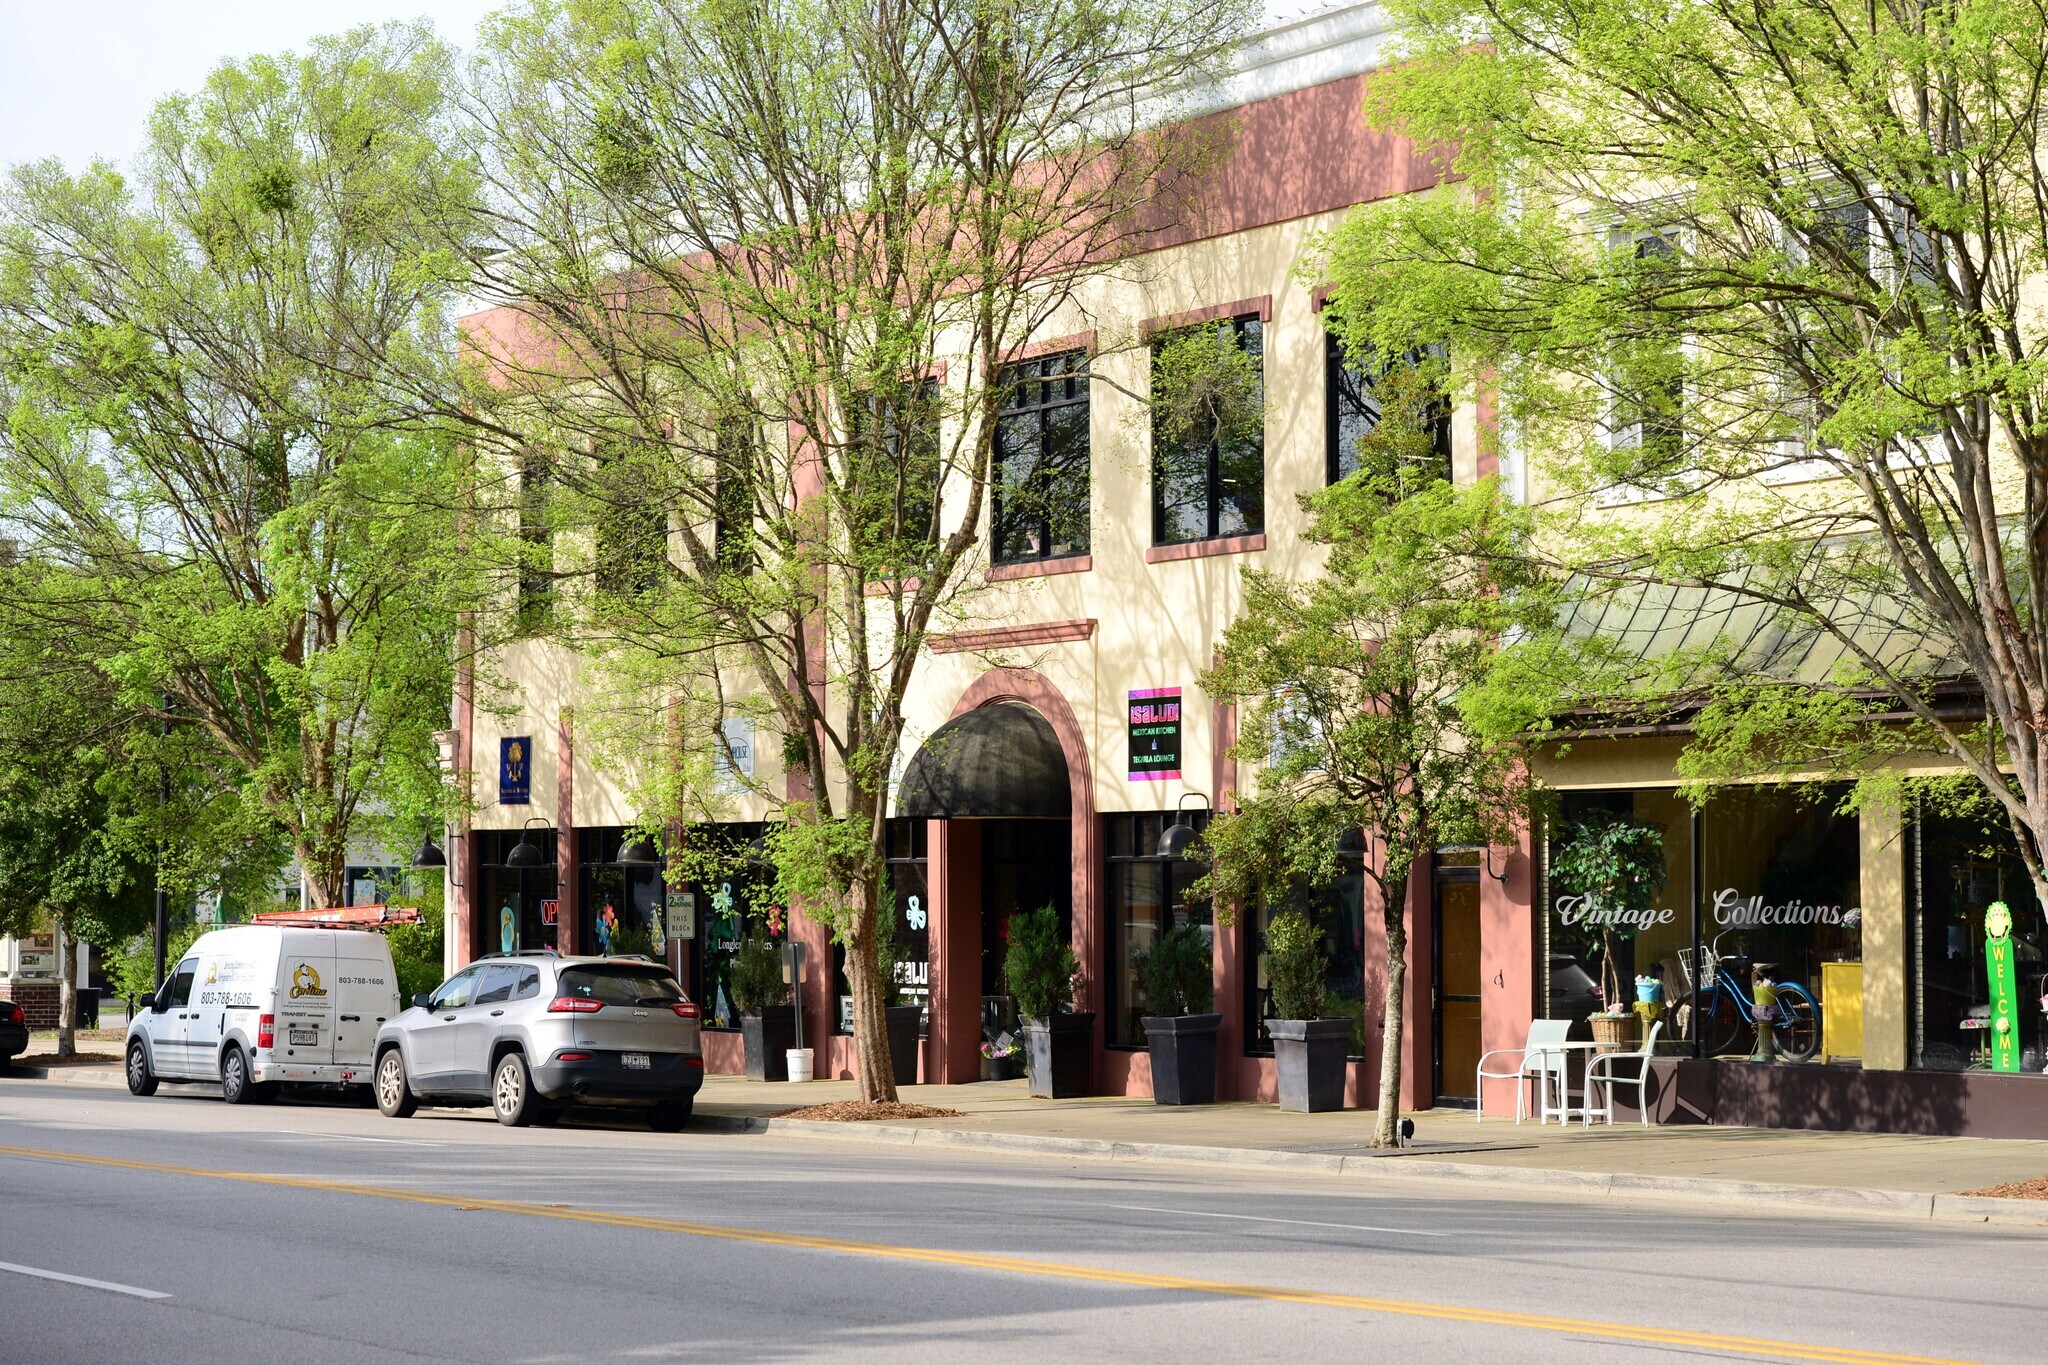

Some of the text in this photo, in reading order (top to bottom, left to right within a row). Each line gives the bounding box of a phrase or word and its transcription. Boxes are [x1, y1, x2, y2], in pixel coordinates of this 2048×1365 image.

[1133, 727, 1176, 736] MEXICAN KITCHEN
[1133, 754, 1175, 763] TEQUILA LOUNGE
[669, 897, 675, 907] 2
[1713, 887, 1844, 925] Collections
[544, 902, 559, 923] OP
[1556, 892, 1676, 931] Vintage
[718, 938, 742, 952] Longlea
[339, 977, 384, 985] 803-788-1606
[201, 992, 252, 1004] 803-788-1606
[632, 1009, 648, 1017] Jeep
[1926, 1053, 1958, 1065] OPEN
